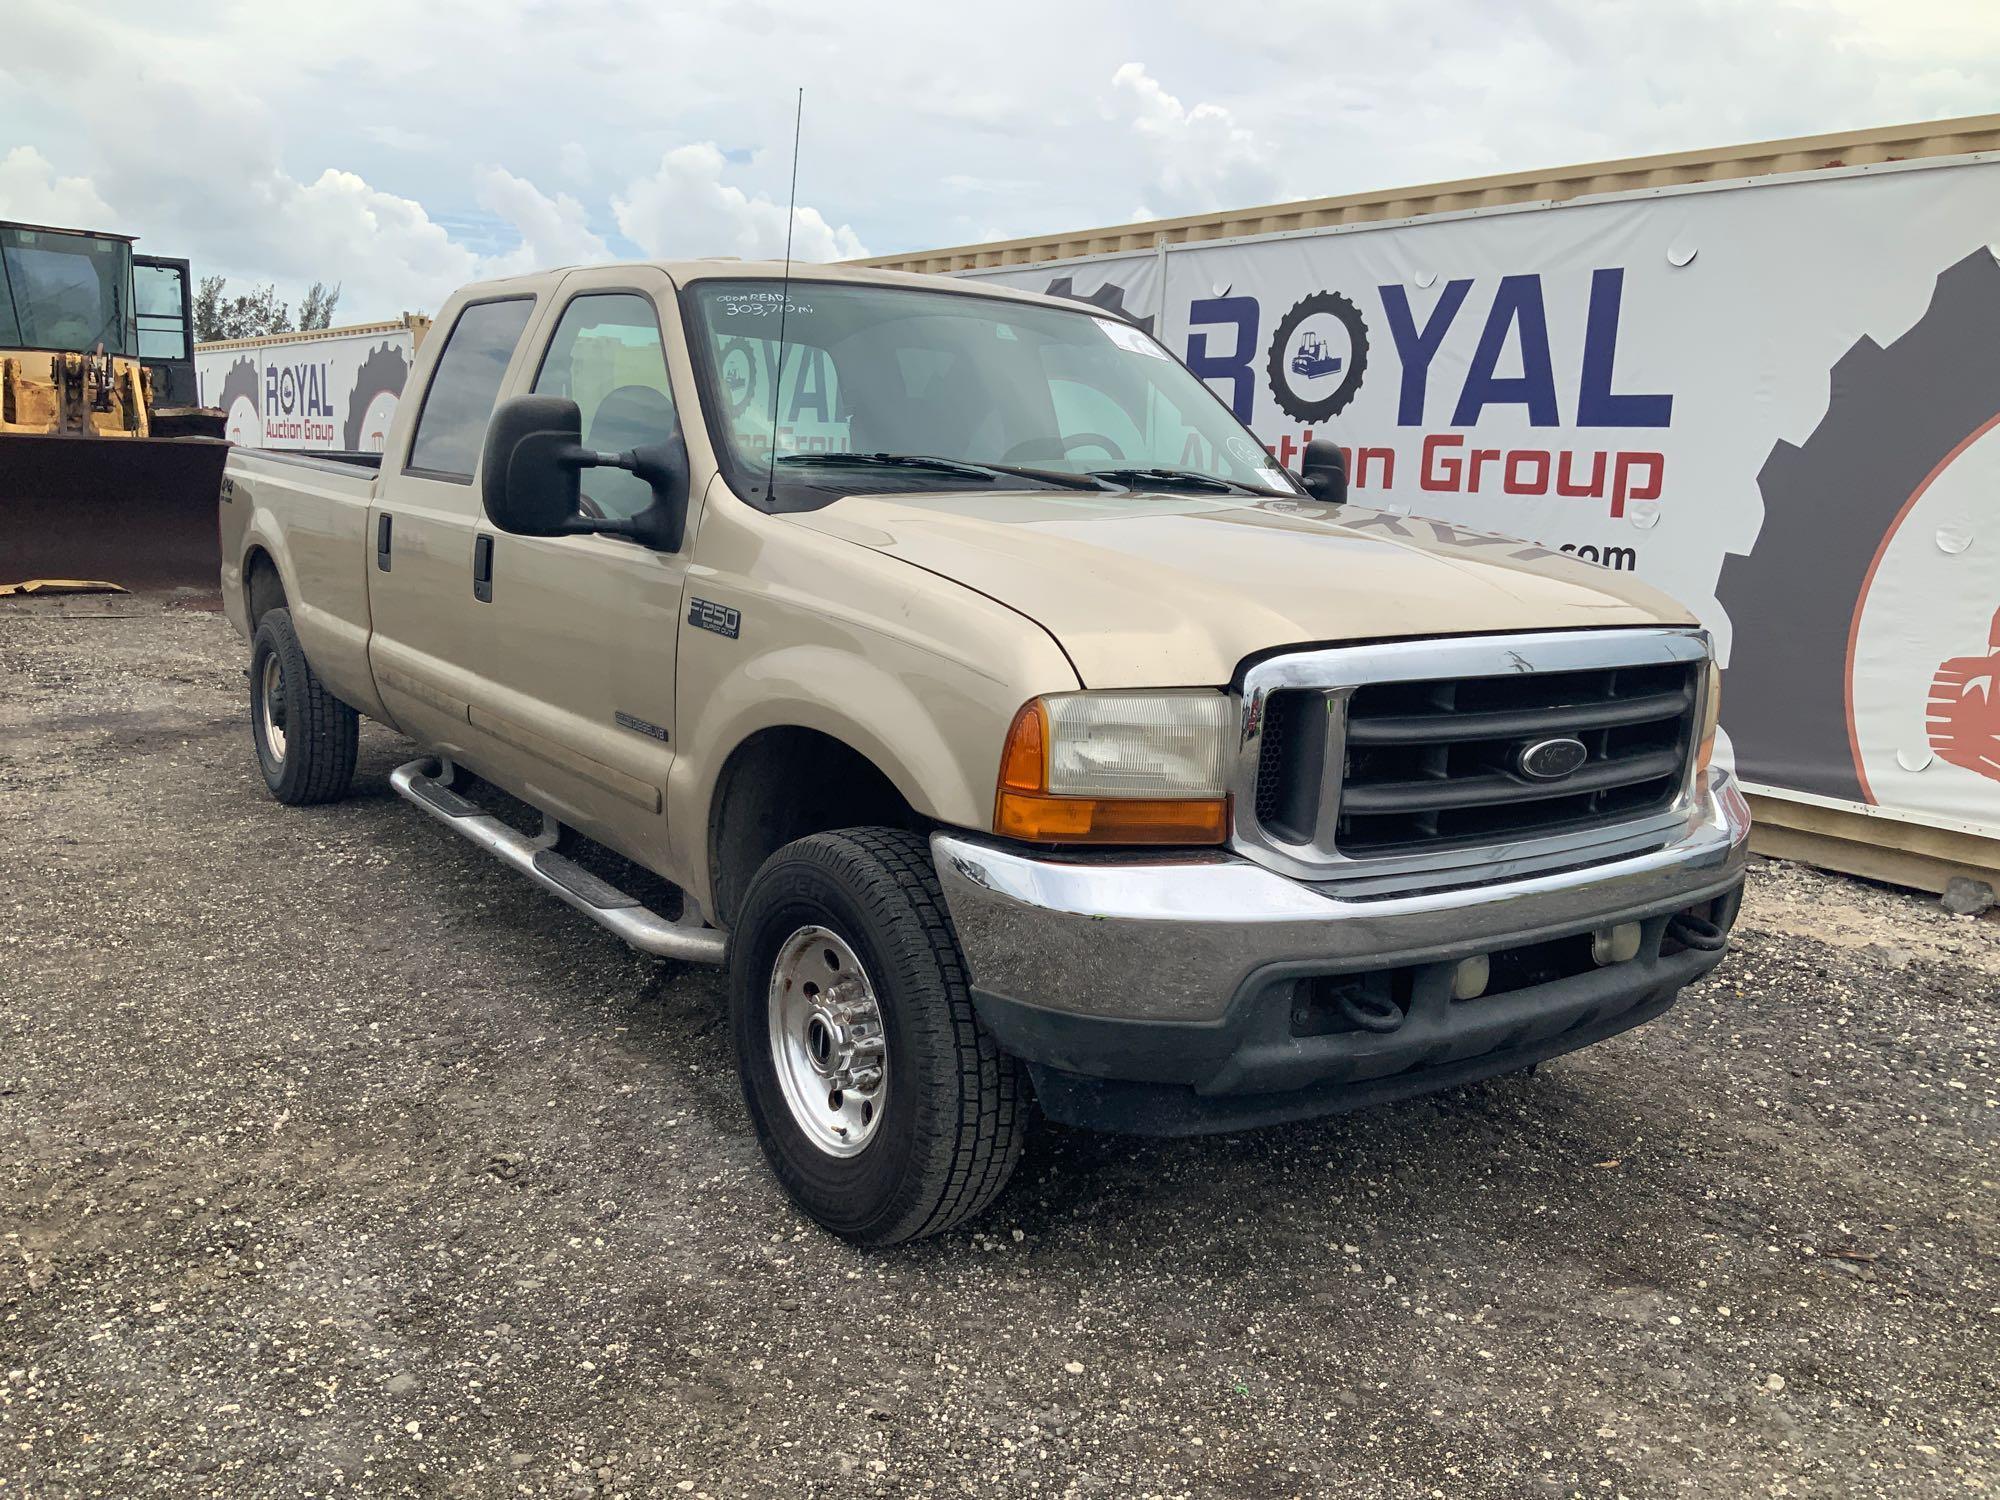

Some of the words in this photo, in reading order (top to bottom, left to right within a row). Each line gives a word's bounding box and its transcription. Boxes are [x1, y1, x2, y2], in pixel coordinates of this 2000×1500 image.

[750, 293, 793, 302] READS
[1187, 268, 1674, 427] ROYAL
[266, 363, 334, 417] ROYAL
[266, 418, 302, 439] Auction
[304, 419, 334, 441] Group
[1420, 433, 1665, 518] Group
[703, 621, 721, 632] SUPER
[720, 626, 736, 637] DUTY
